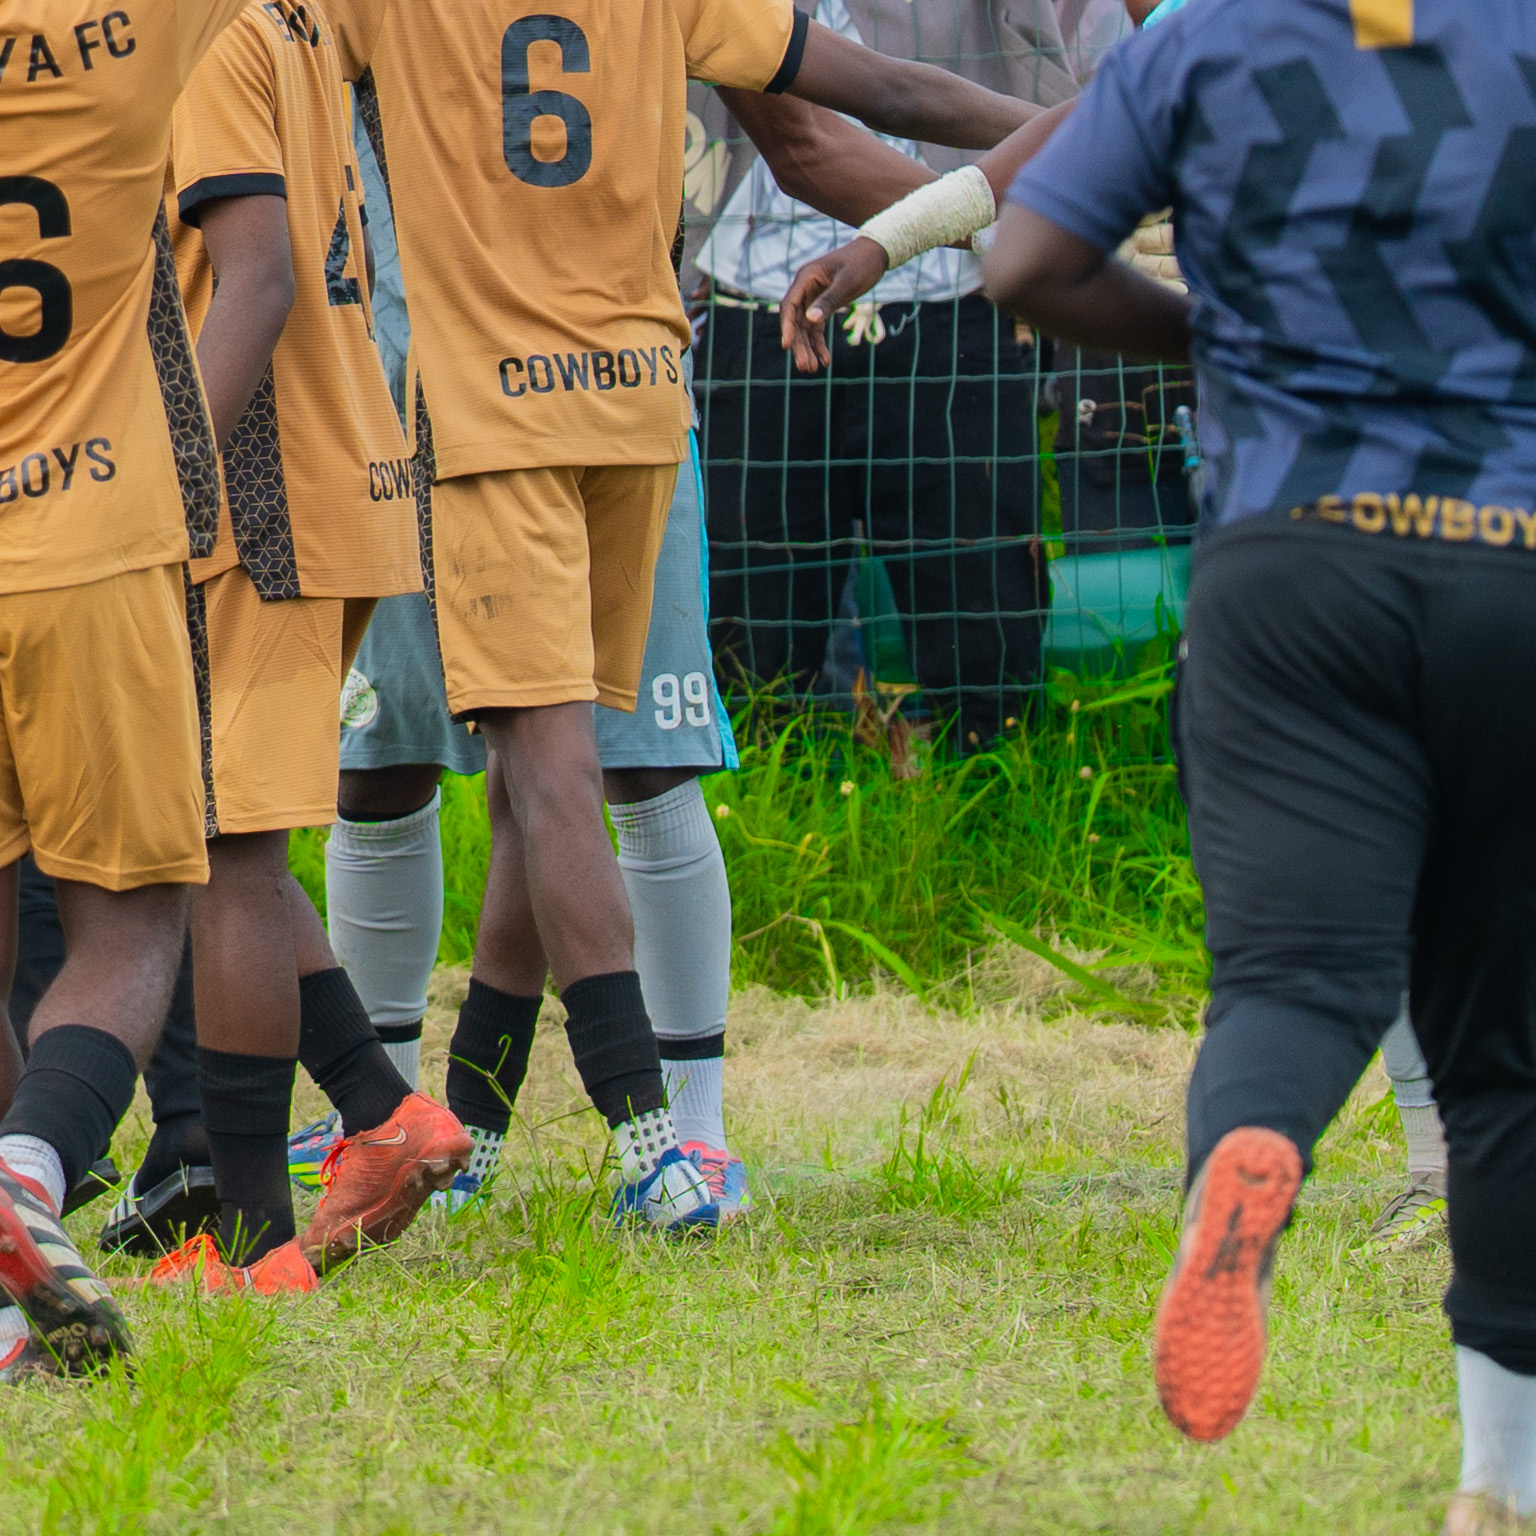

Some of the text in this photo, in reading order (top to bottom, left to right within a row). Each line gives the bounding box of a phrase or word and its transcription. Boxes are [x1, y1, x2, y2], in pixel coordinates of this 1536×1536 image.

[74, 10, 137, 71] FC
[501, 14, 592, 188] 6
[498, 344, 678, 398] COWBOYS
[369, 457, 416, 502] COW
[652, 671, 711, 730] 99
